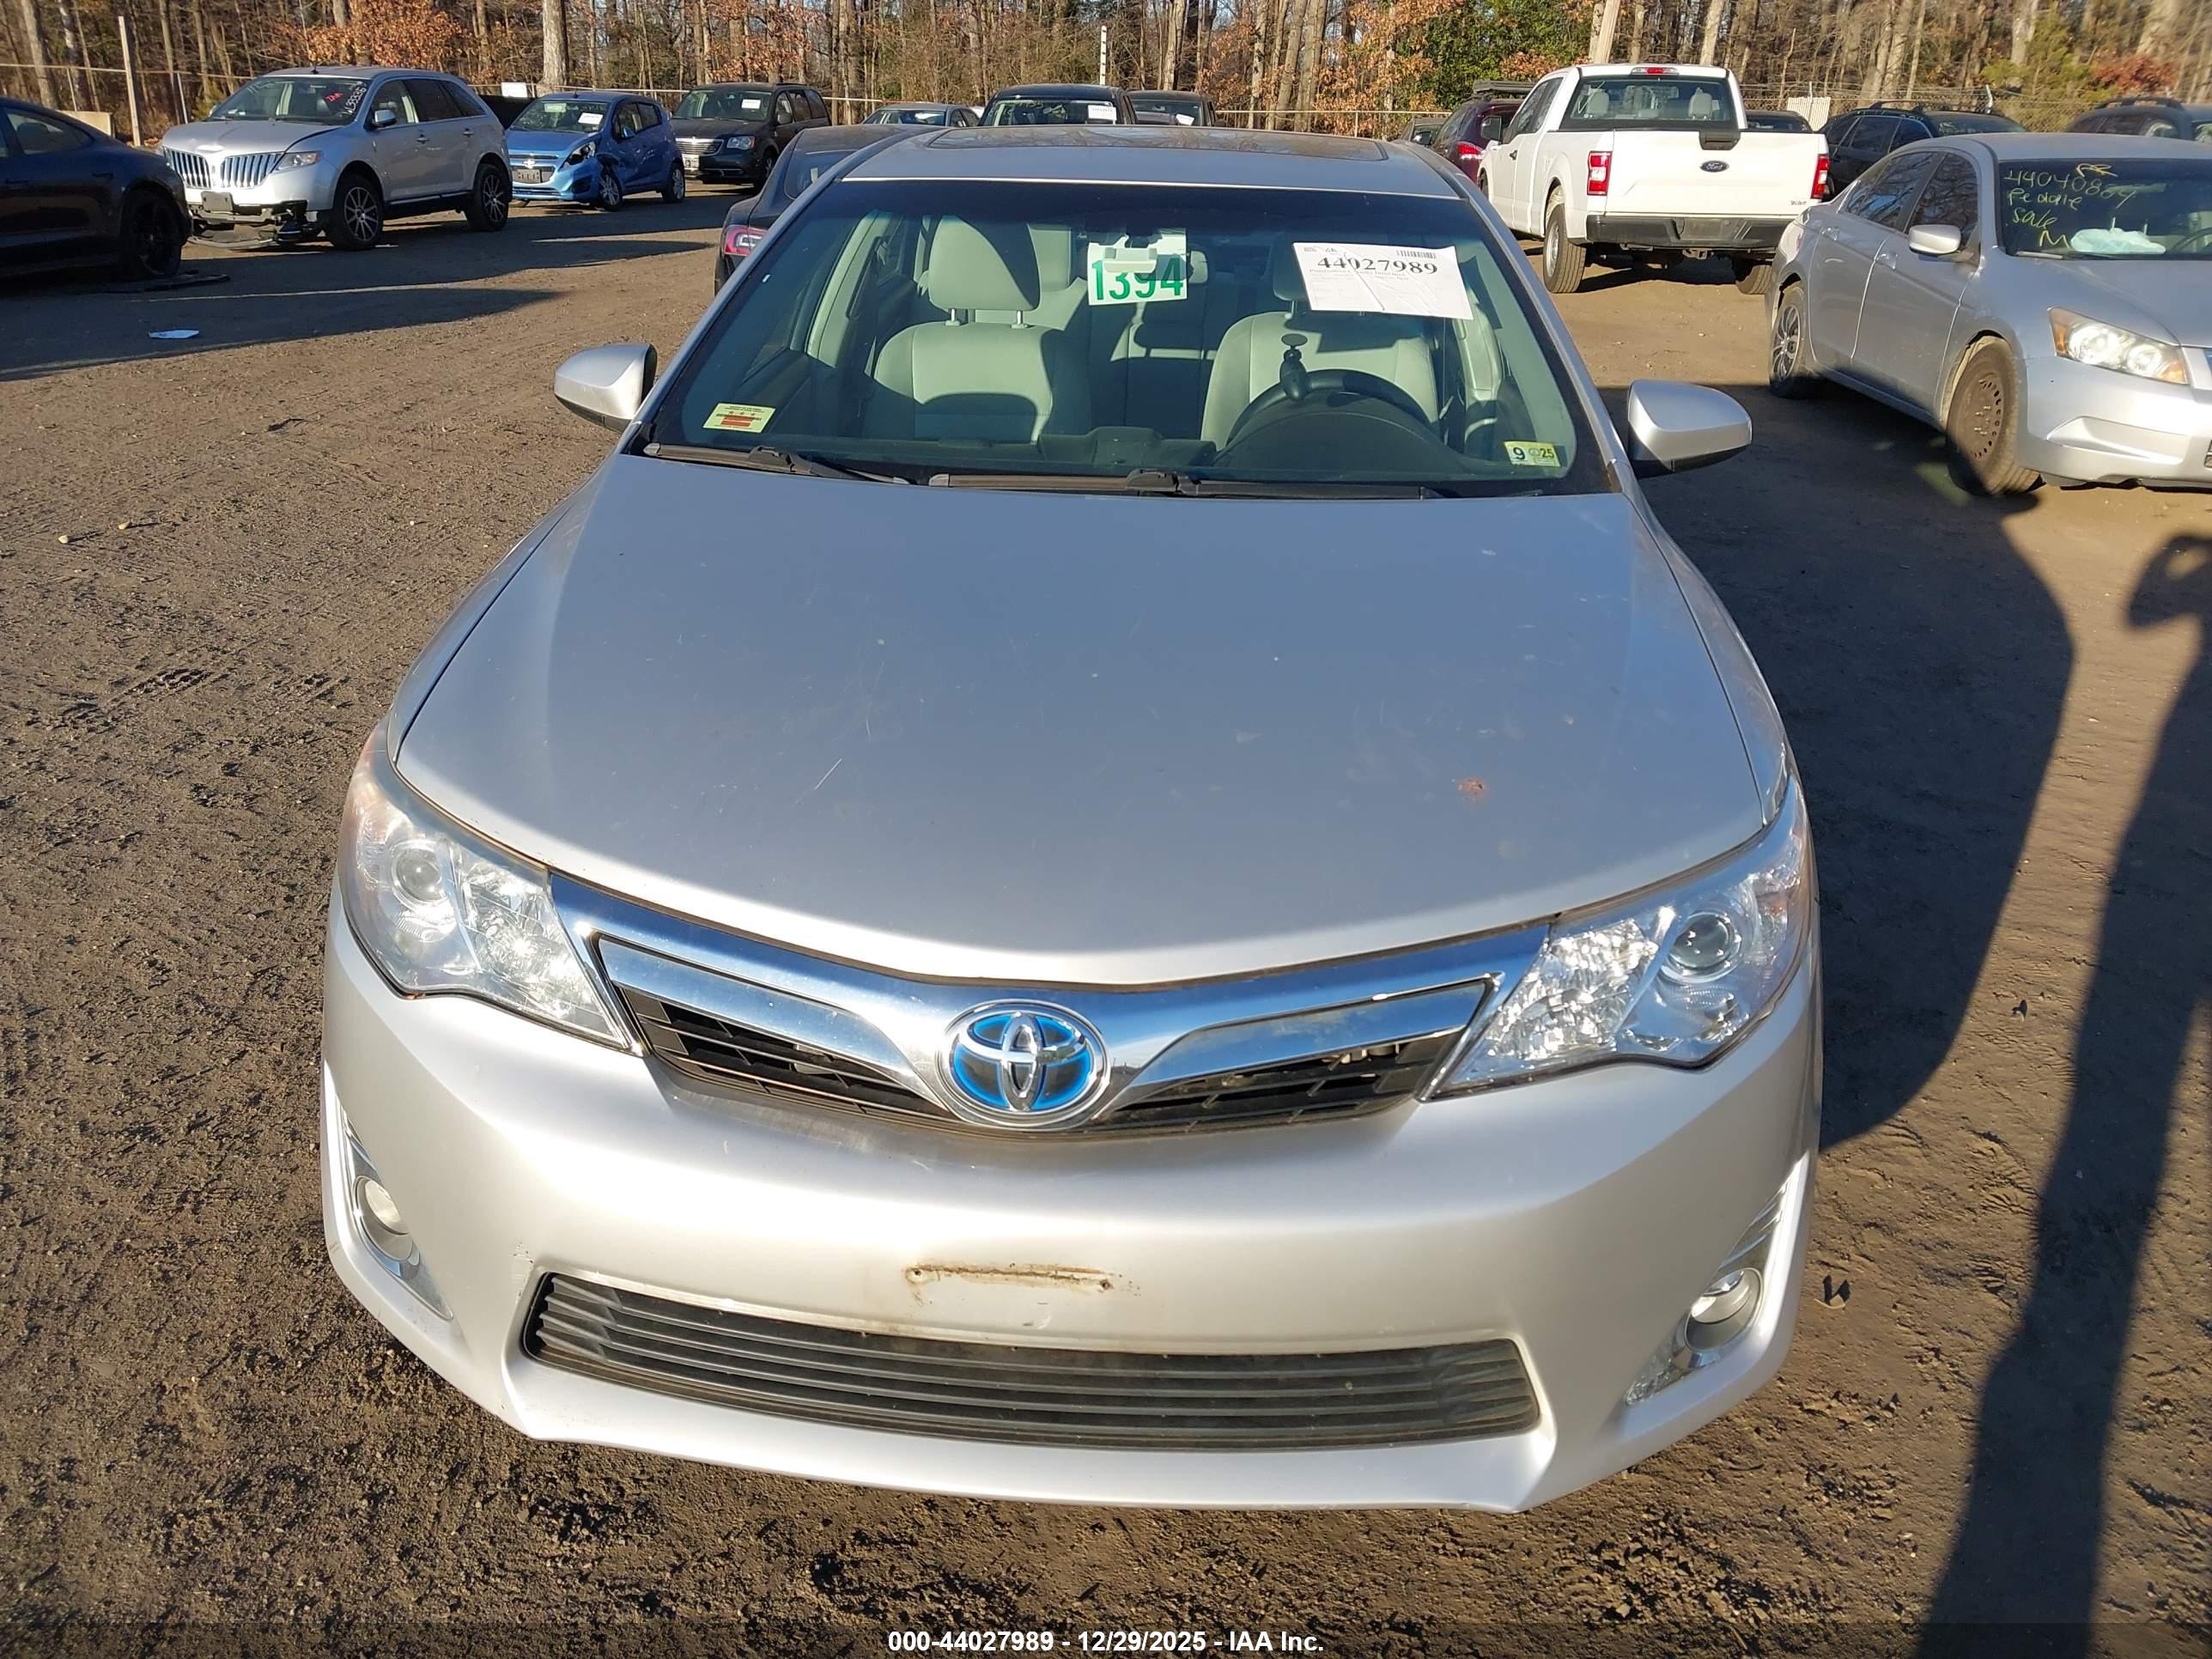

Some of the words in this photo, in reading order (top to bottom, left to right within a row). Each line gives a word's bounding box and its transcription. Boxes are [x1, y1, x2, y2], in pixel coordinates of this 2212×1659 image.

[1317, 257, 1438, 275] 44027989
[1091, 257, 1184, 301] 1394
[1512, 447, 1526, 460] 9
[1540, 447, 1555, 459] 25
